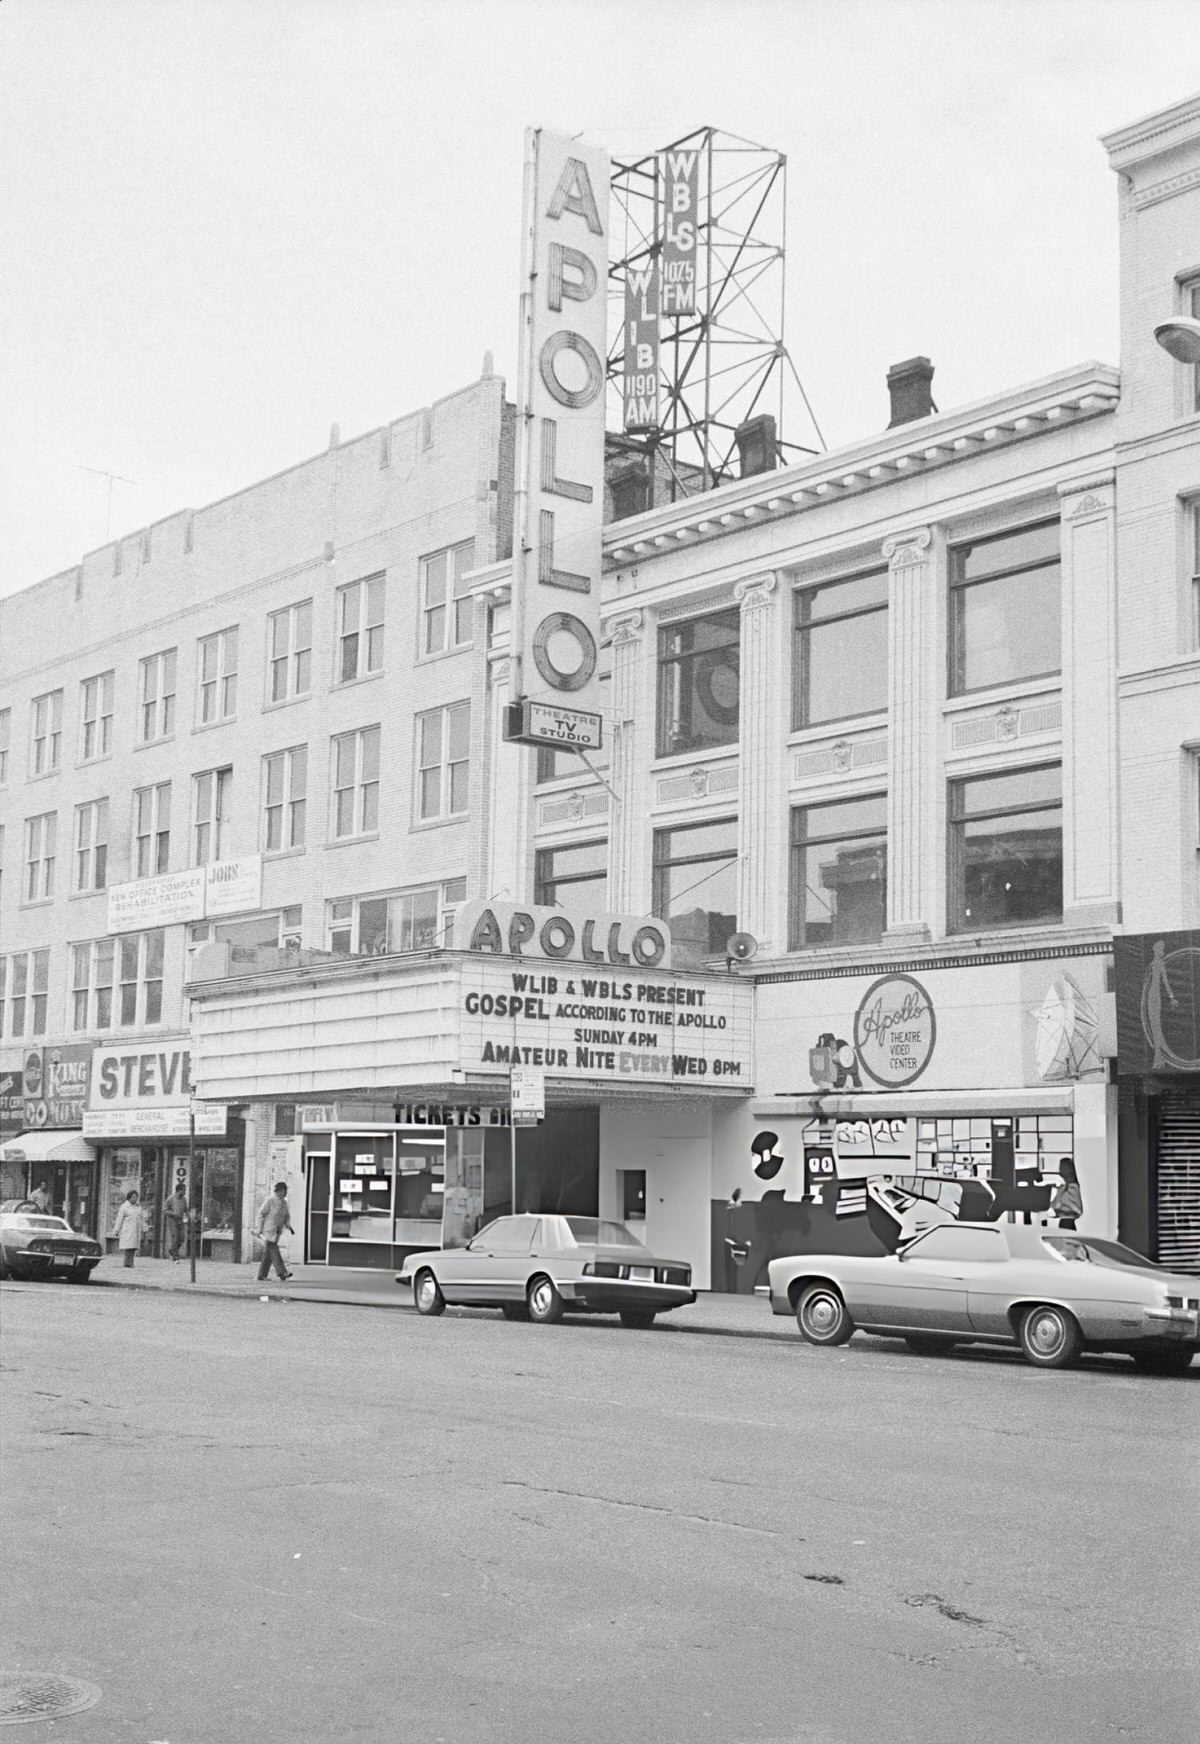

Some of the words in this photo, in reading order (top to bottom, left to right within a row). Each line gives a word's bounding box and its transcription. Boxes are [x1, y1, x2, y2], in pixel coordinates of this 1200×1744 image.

[667, 151, 697, 251] WBLS
[663, 283, 694, 310] FM
[626, 271, 657, 370] WLIB
[626, 373, 656, 397] 1190
[533, 156, 603, 692] APOLLO
[625, 396, 657, 425] AM
[533, 706, 598, 726] THEATRE
[555, 719, 577, 732] TV
[540, 727, 591, 743] STUDIO
[129, 886, 157, 899] OFFICE
[160, 878, 201, 893] COMPLEX
[470, 908, 665, 967] APOLLO
[512, 972, 558, 995] WLIB
[566, 980, 576, 995] &
[581, 979, 633, 1000] WBLS
[637, 984, 706, 1007] PRESENT
[465, 992, 550, 1020] GOSPEL
[555, 1003, 626, 1022] ACCORDING
[630, 1008, 646, 1023] TO
[648, 1010, 673, 1025] THE
[677, 1012, 727, 1029] APOLLO
[860, 991, 931, 1048] Apollo
[574, 1028, 625, 1046] SUNDAY
[889, 1031, 922, 1043] THEATRE
[889, 1044, 911, 1056] VIDEO
[481, 1040, 568, 1068] AMATEUR
[576, 1046, 616, 1069] NITE
[619, 1051, 670, 1073] EVERY
[672, 1054, 708, 1076] WED
[889, 1057, 918, 1069] CENTER
[48, 1061, 88, 1098] KING
[392, 1103, 481, 1126] TICKETS
